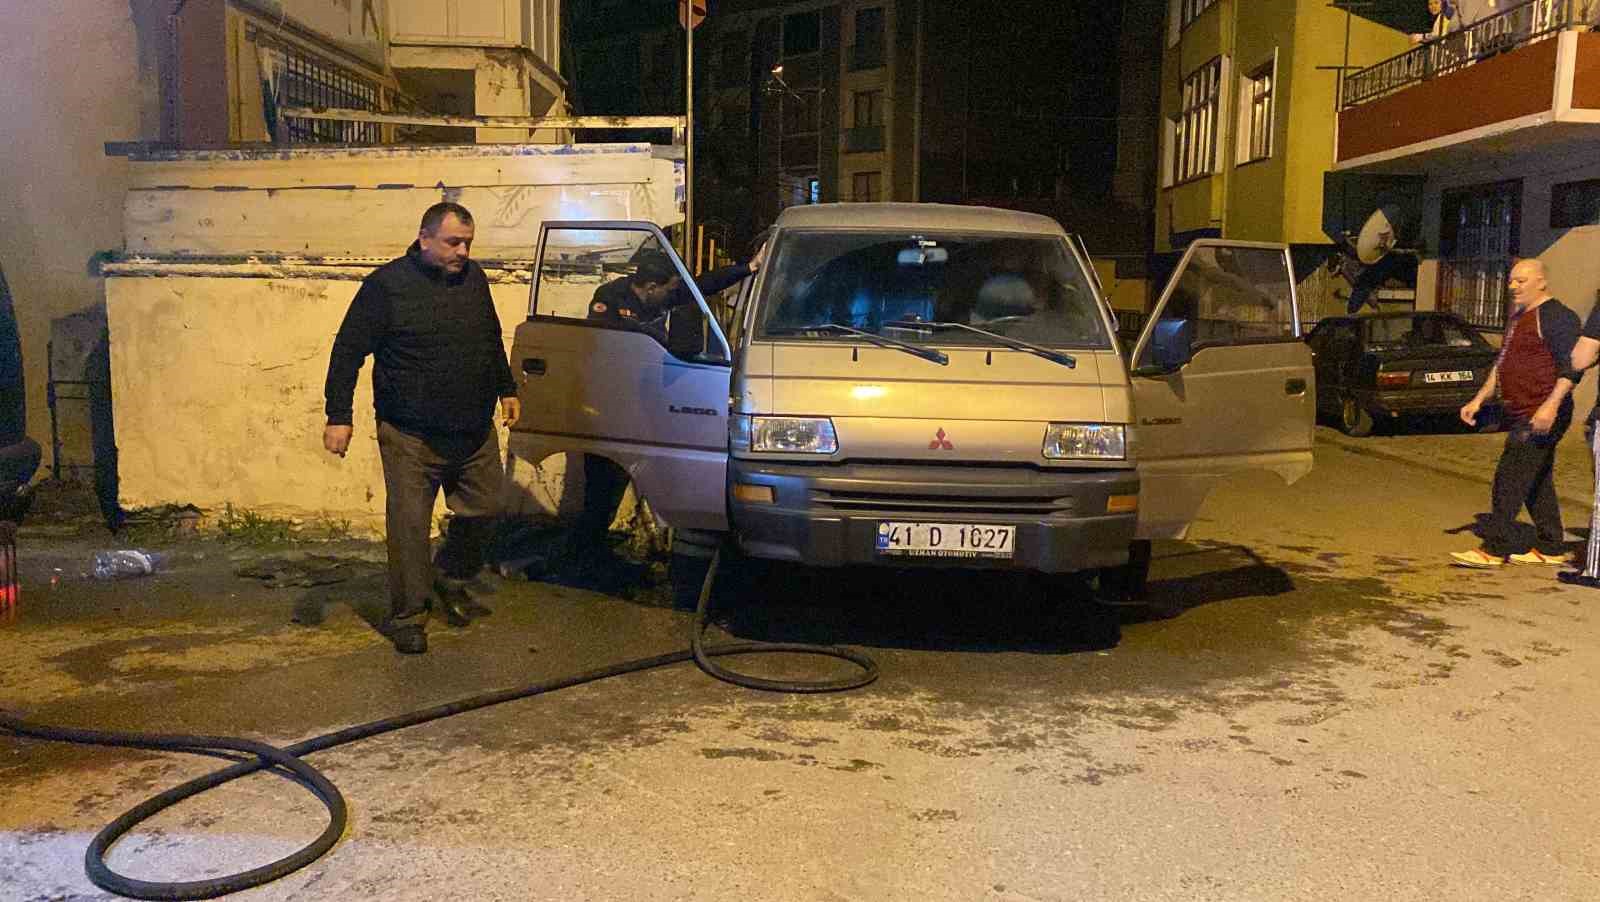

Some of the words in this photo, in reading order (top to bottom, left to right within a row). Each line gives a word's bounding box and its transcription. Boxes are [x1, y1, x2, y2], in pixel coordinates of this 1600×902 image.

[889, 526, 912, 547] 41
[929, 526, 942, 547] D
[959, 527, 1009, 549] 1027
